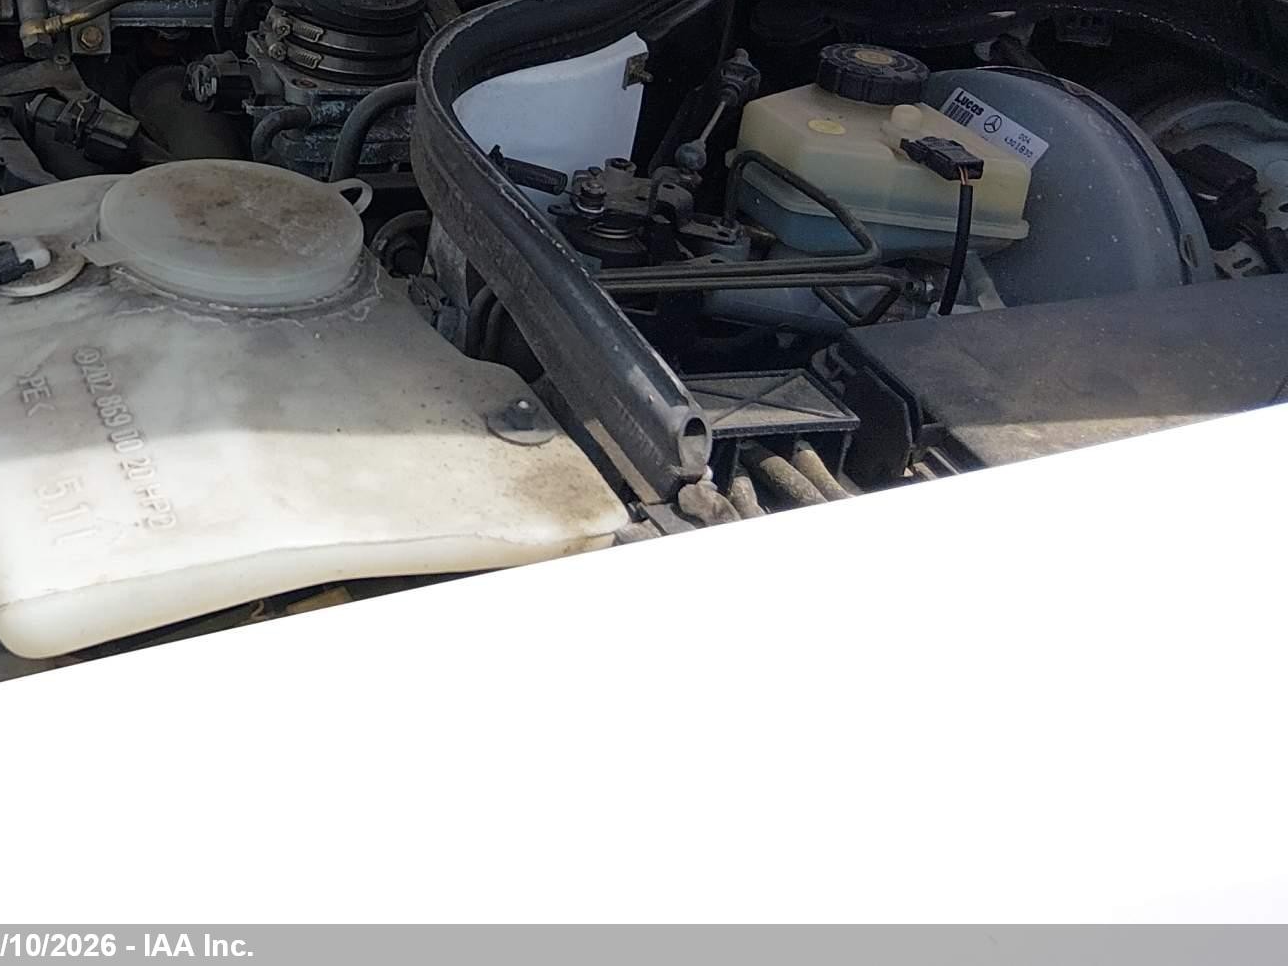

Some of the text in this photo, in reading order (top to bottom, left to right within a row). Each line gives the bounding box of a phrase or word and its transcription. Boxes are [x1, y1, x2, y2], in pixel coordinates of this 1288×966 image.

[954, 90, 985, 116] Lucas
[81, 362, 115, 395] 202
[95, 394, 133, 427] 869
[122, 457, 155, 481] 20
